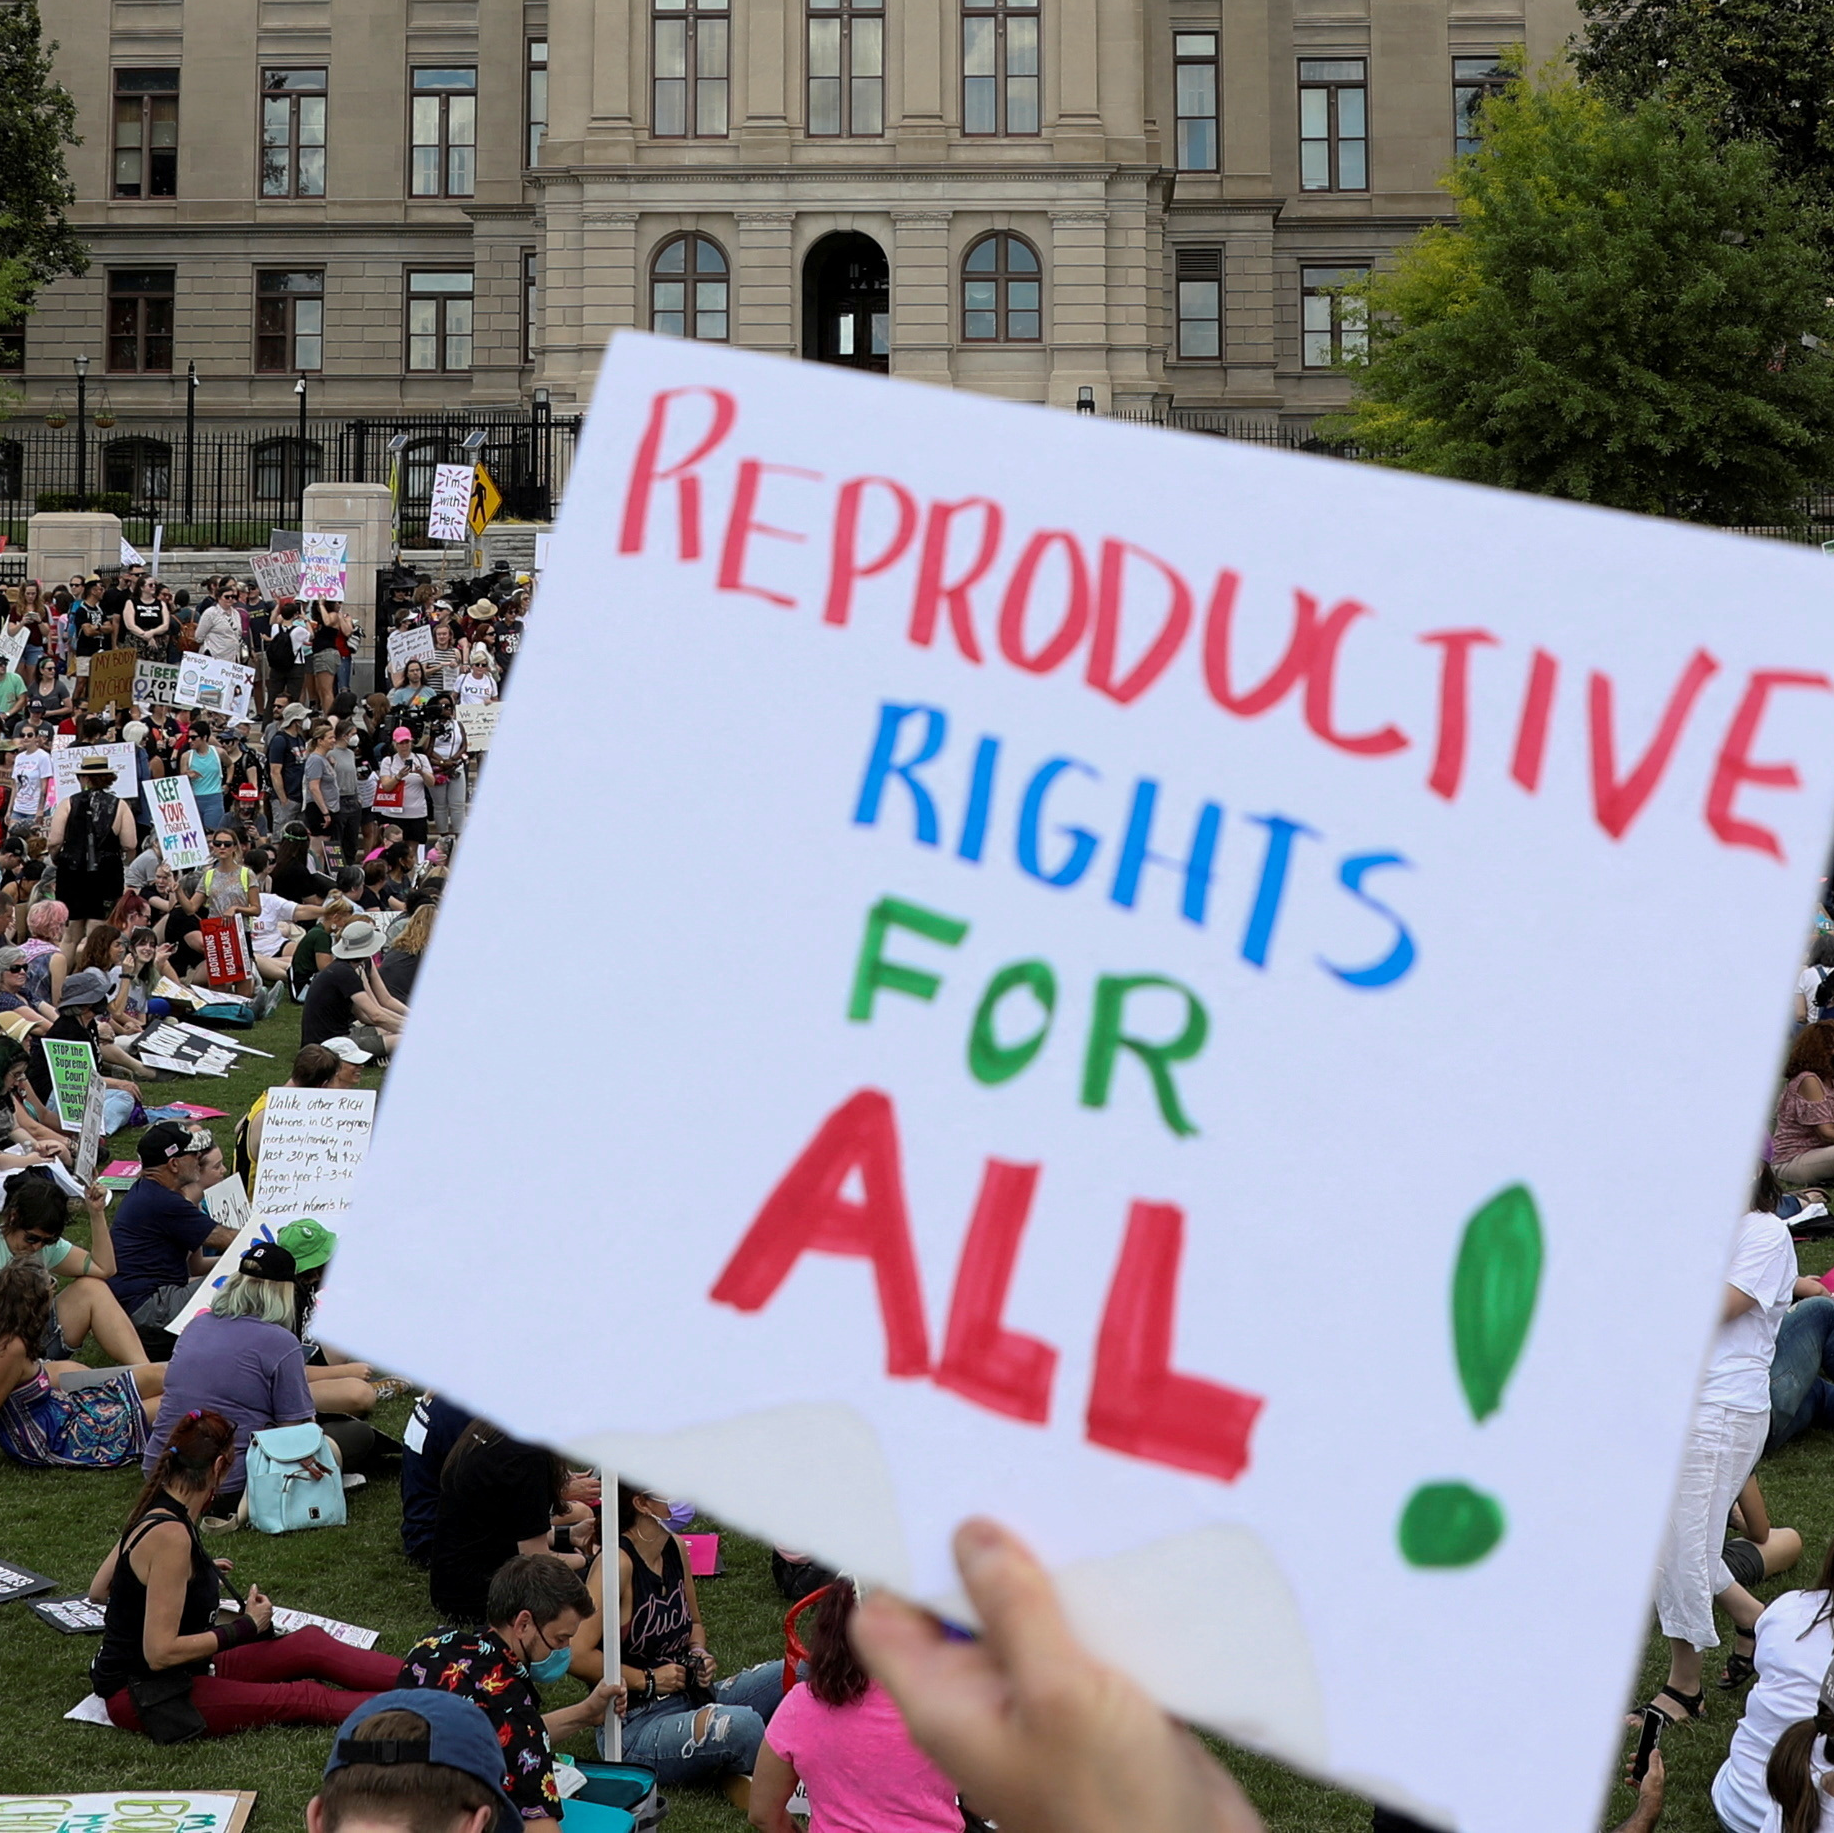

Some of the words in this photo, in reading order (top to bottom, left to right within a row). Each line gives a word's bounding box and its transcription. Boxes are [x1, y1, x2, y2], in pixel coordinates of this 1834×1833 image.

[445, 475, 460, 487] I'm
[439, 495, 460, 507] with
[617, 386, 1834, 863] REPRODUCTIVE
[112, 650, 135, 666] BODY
[182, 653, 206, 665] Person
[231, 663, 245, 673] Not
[199, 676, 224, 686] Person
[220, 668, 244, 680] Person
[150, 679, 176, 690] FOR
[464, 686, 490, 696] VOTE
[144, 690, 178, 704] ALL
[152, 777, 179, 801] KEEP
[157, 802, 188, 823] YOUR
[162, 832, 179, 850] OFF
[180, 829, 198, 849] MY
[853, 700, 1419, 990] RIGHTS
[204, 934, 221, 978] ABORTIONS
[220, 930, 237, 976] HEALTHCARE
[846, 894, 1212, 1140] FOR
[52, 1043, 70, 1056] STOP
[70, 1046, 84, 1057] the
[54, 1056, 88, 1071] Supreme
[64, 1070, 85, 1083] Court
[268, 1094, 301, 1111] Unlike
[307, 1094, 333, 1110] other
[320, 1116, 333, 1127] US
[262, 1149, 284, 1163] last
[255, 1200, 299, 1215] Support
[707, 1084, 1266, 1487] ALL
[1395, 1179, 1547, 1573] !
